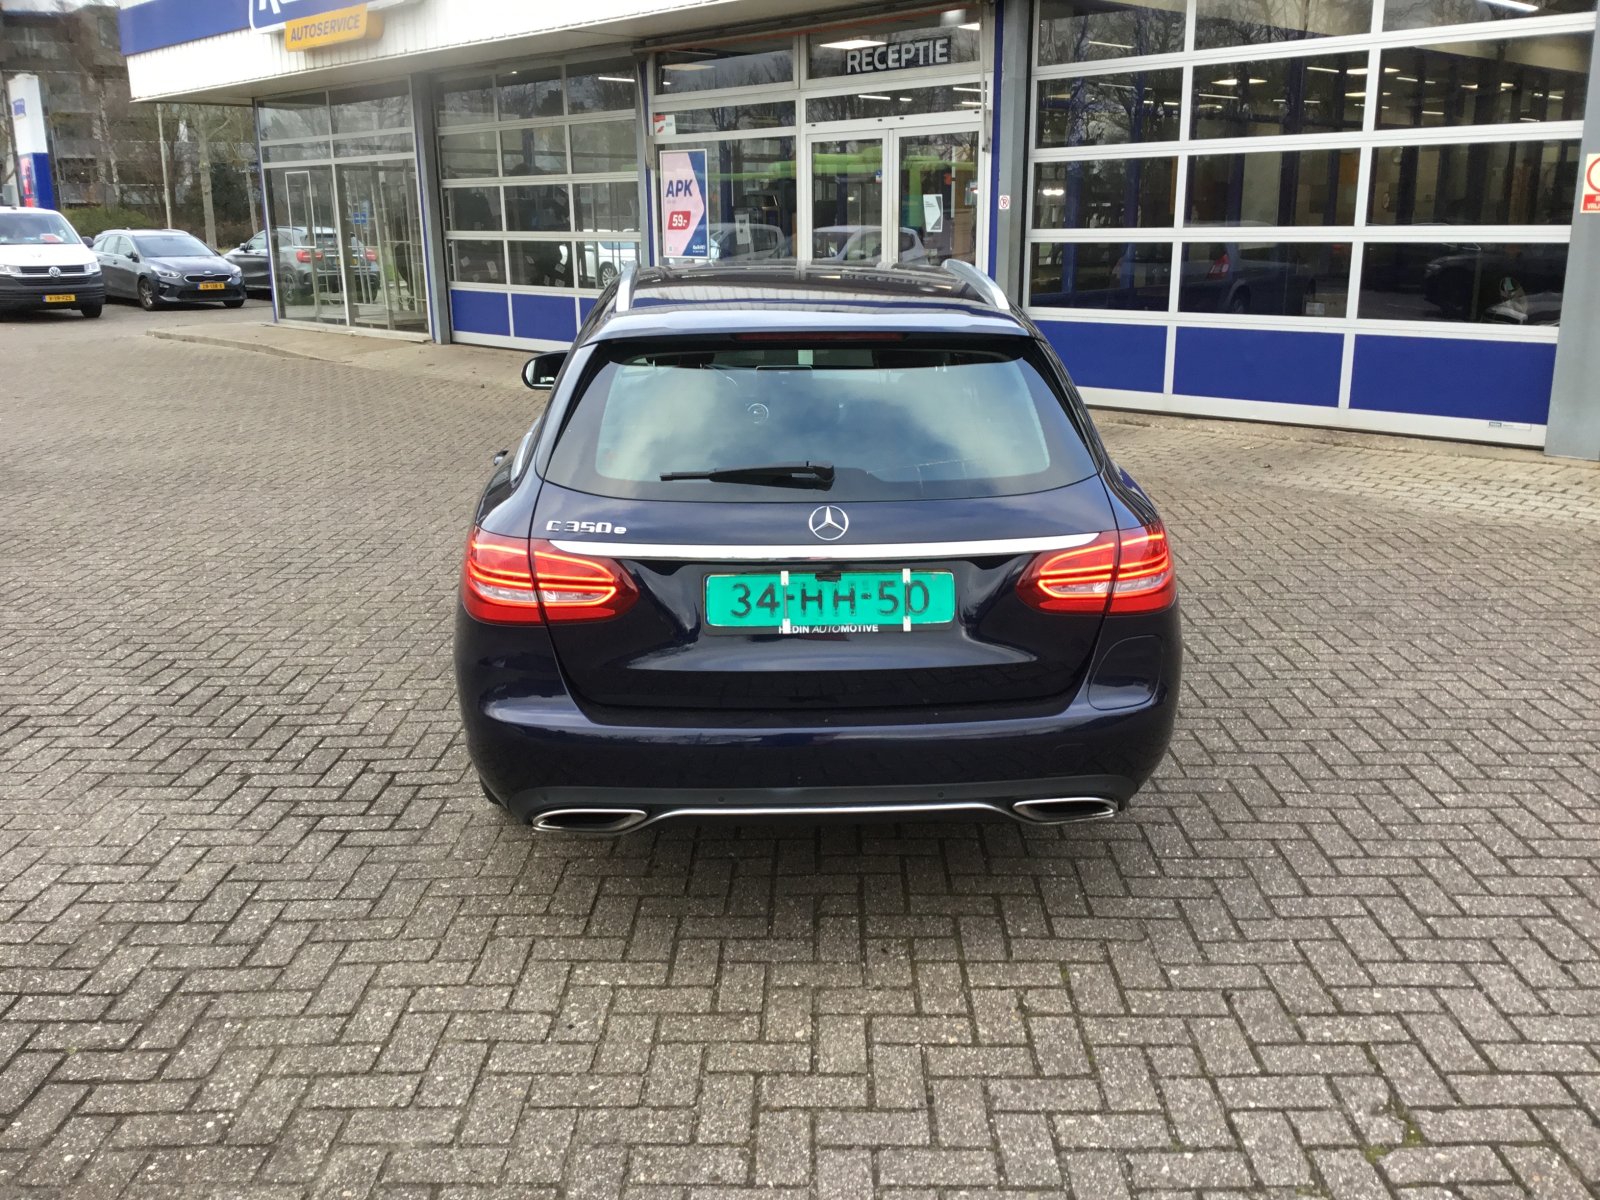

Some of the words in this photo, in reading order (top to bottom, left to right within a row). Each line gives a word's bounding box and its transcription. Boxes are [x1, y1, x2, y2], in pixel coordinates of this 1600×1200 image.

[290, 14, 361, 42] AUTOSERVICE
[846, 38, 948, 74] RECEPTIE
[665, 179, 693, 198] APK
[545, 520, 562, 532] C
[563, 521, 612, 534] 350
[613, 526, 628, 535] e
[730, 580, 930, 618] 34-HH-50
[778, 624, 810, 634] HDIN
[811, 624, 879, 634] AUTOMOTIVE
